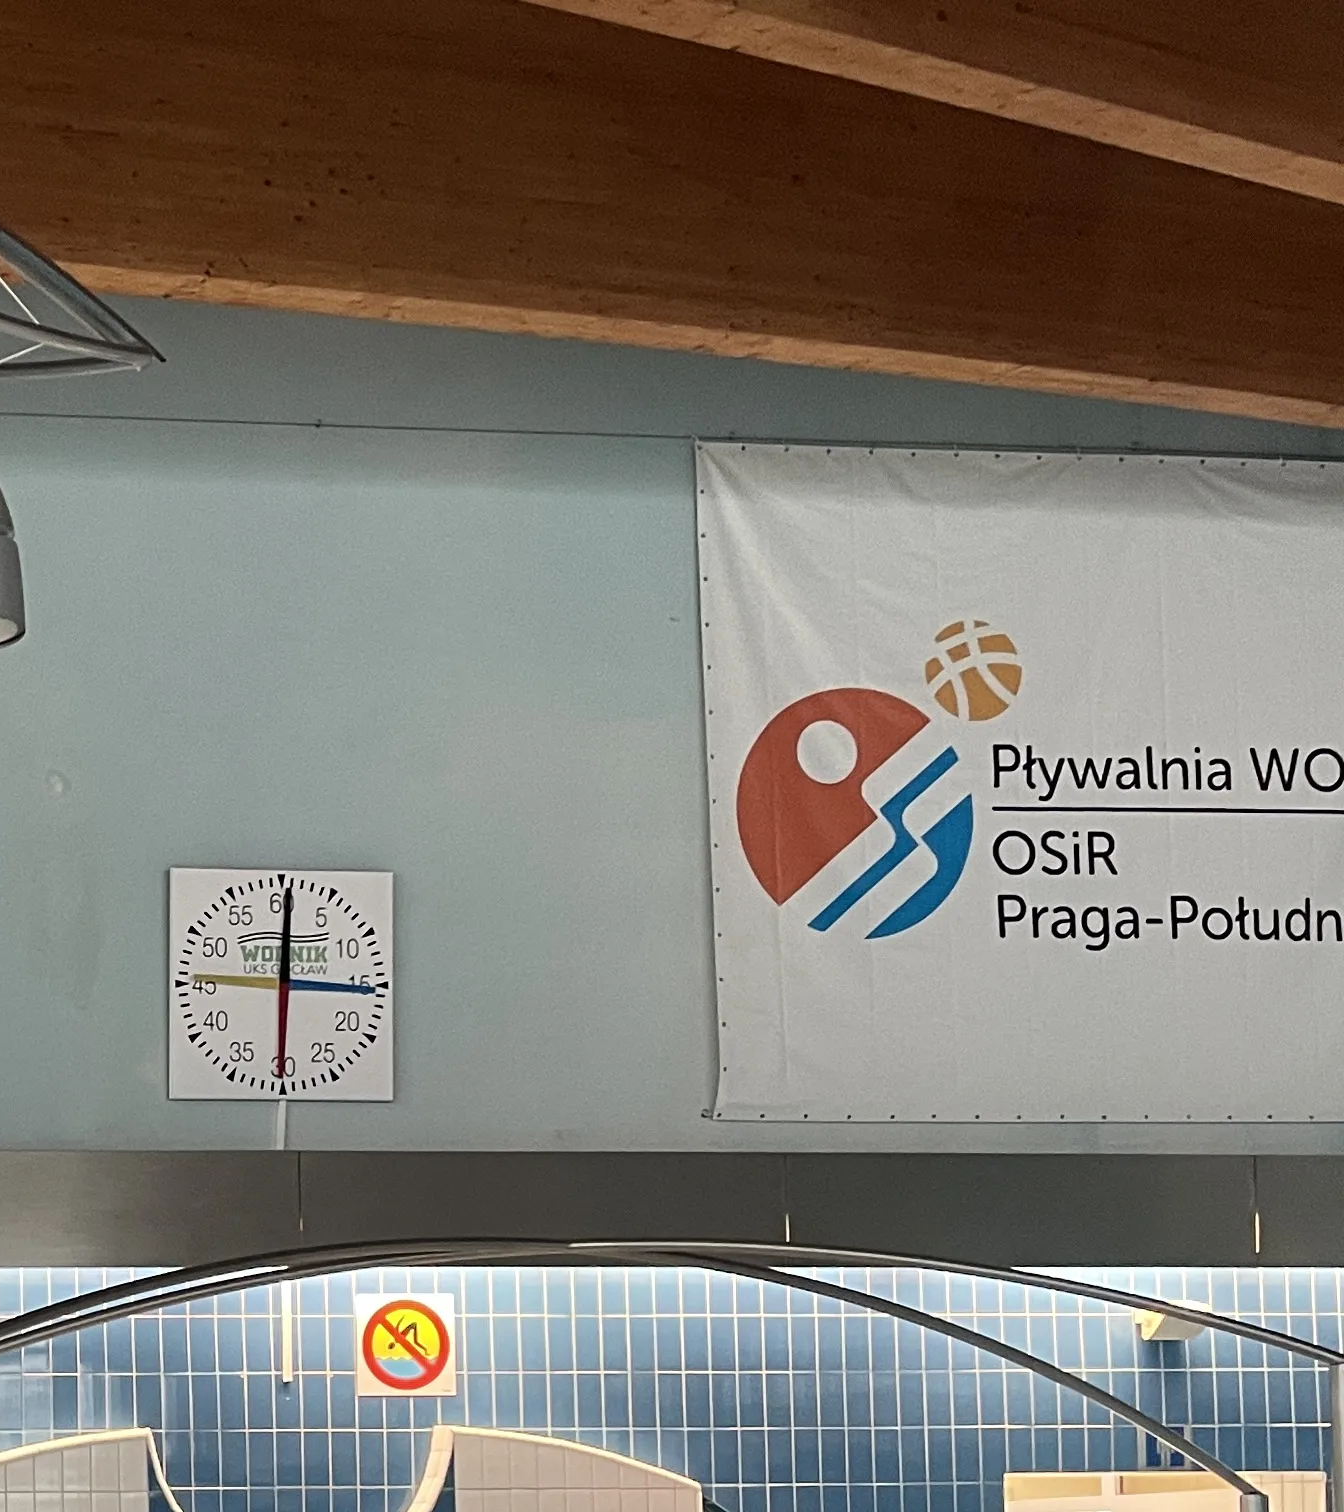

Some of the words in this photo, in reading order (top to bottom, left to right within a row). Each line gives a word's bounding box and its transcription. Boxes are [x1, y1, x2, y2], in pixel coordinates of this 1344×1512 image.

[992, 743, 1232, 802] Pływalnia
[1249, 747, 1344, 793] WO
[992, 830, 1118, 876] OSiR
[228, 905, 253, 926] 55
[315, 907, 328, 928] 5
[997, 894, 1343, 952] Praga-Połudn
[202, 937, 228, 958] 50
[336, 938, 360, 959] 10
[271, 963, 328, 975] GCŁAW
[203, 1010, 229, 1032] 40
[334, 1011, 360, 1032] 20
[229, 1041, 255, 1063] 35
[310, 1042, 336, 1064] 25
